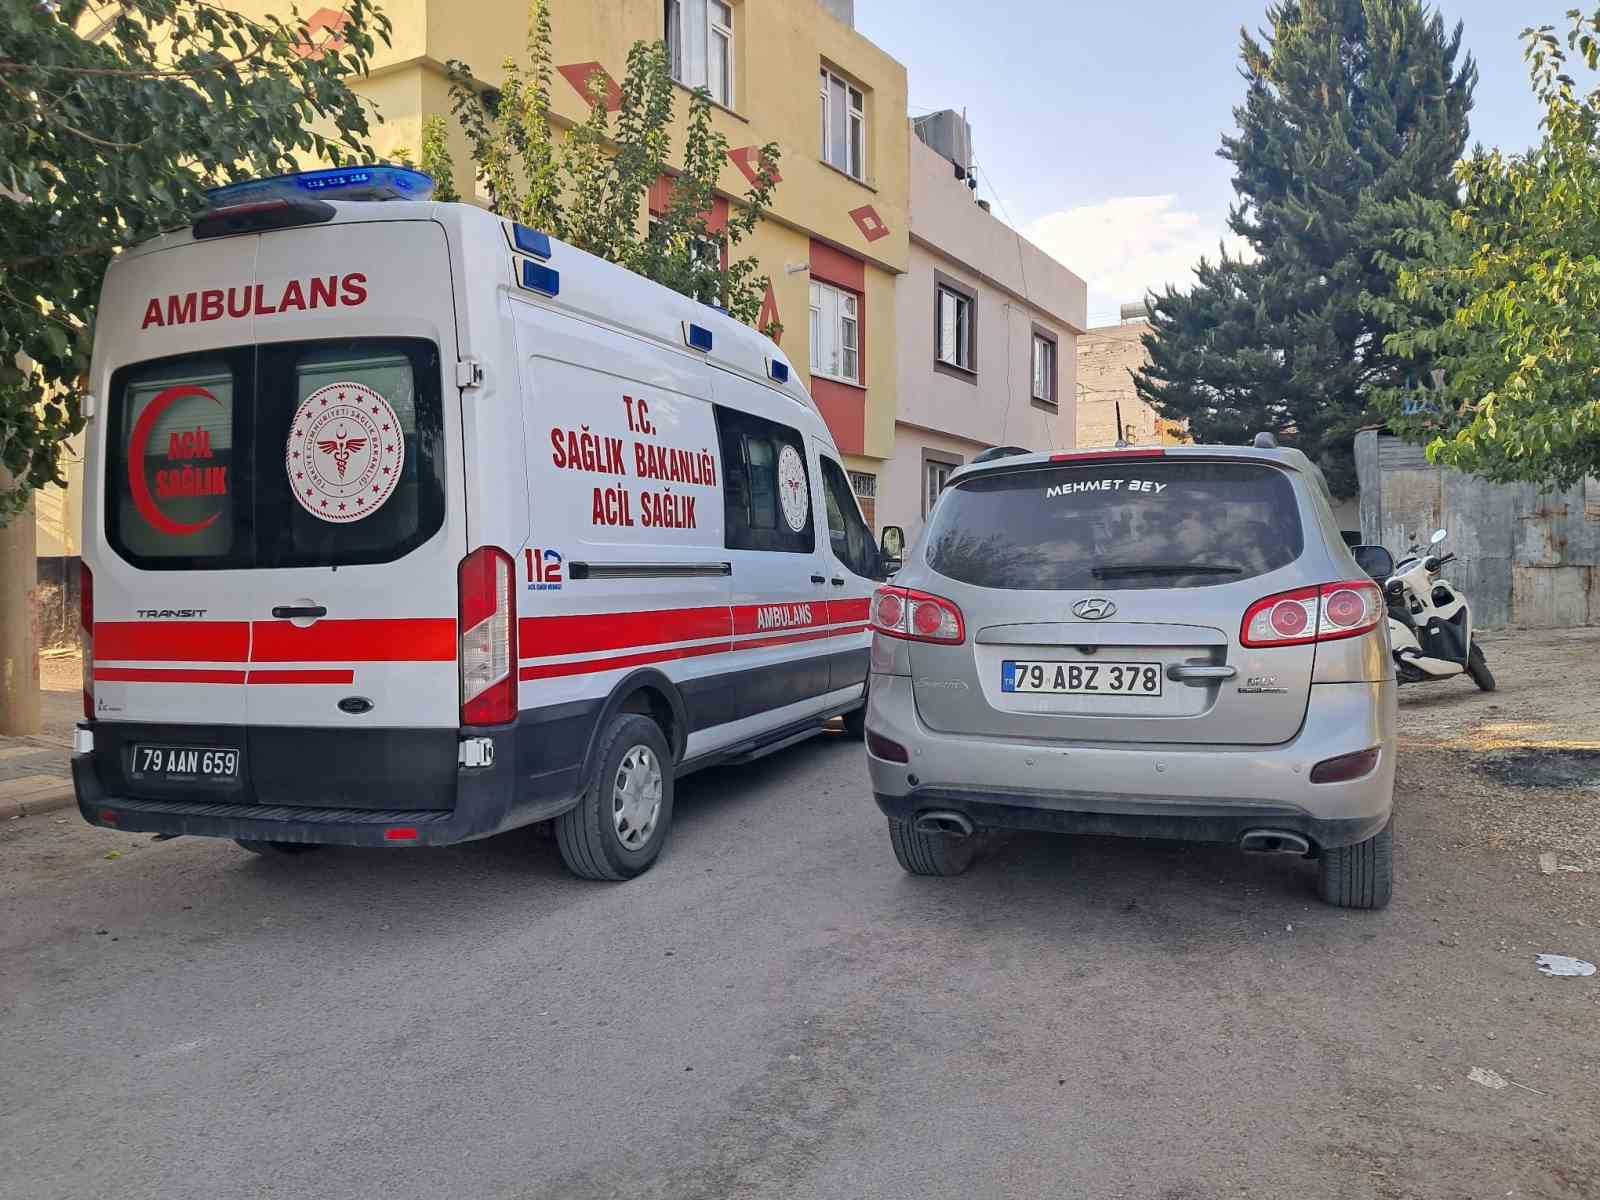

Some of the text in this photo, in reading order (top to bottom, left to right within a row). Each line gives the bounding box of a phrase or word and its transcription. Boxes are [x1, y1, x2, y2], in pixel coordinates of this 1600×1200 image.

[141, 272, 368, 330] AMBULANS
[622, 395, 656, 435] T.C.
[168, 426, 212, 460] ACİL
[551, 424, 717, 487] SAĞLIK BAKANLIĞI
[155, 464, 227, 497] SAĞLIK
[1046, 479, 1167, 498] MEHMET BEY
[592, 482, 696, 529] ACİL SAĞLIK
[525, 548, 562, 582] 112
[137, 609, 207, 618] TRANSIT
[757, 603, 812, 629] AMBULANS
[1015, 664, 1044, 689] 79
[1053, 665, 1100, 691] ABZ
[1109, 666, 1157, 691] 378
[143, 749, 235, 775] 79 AAN 659
